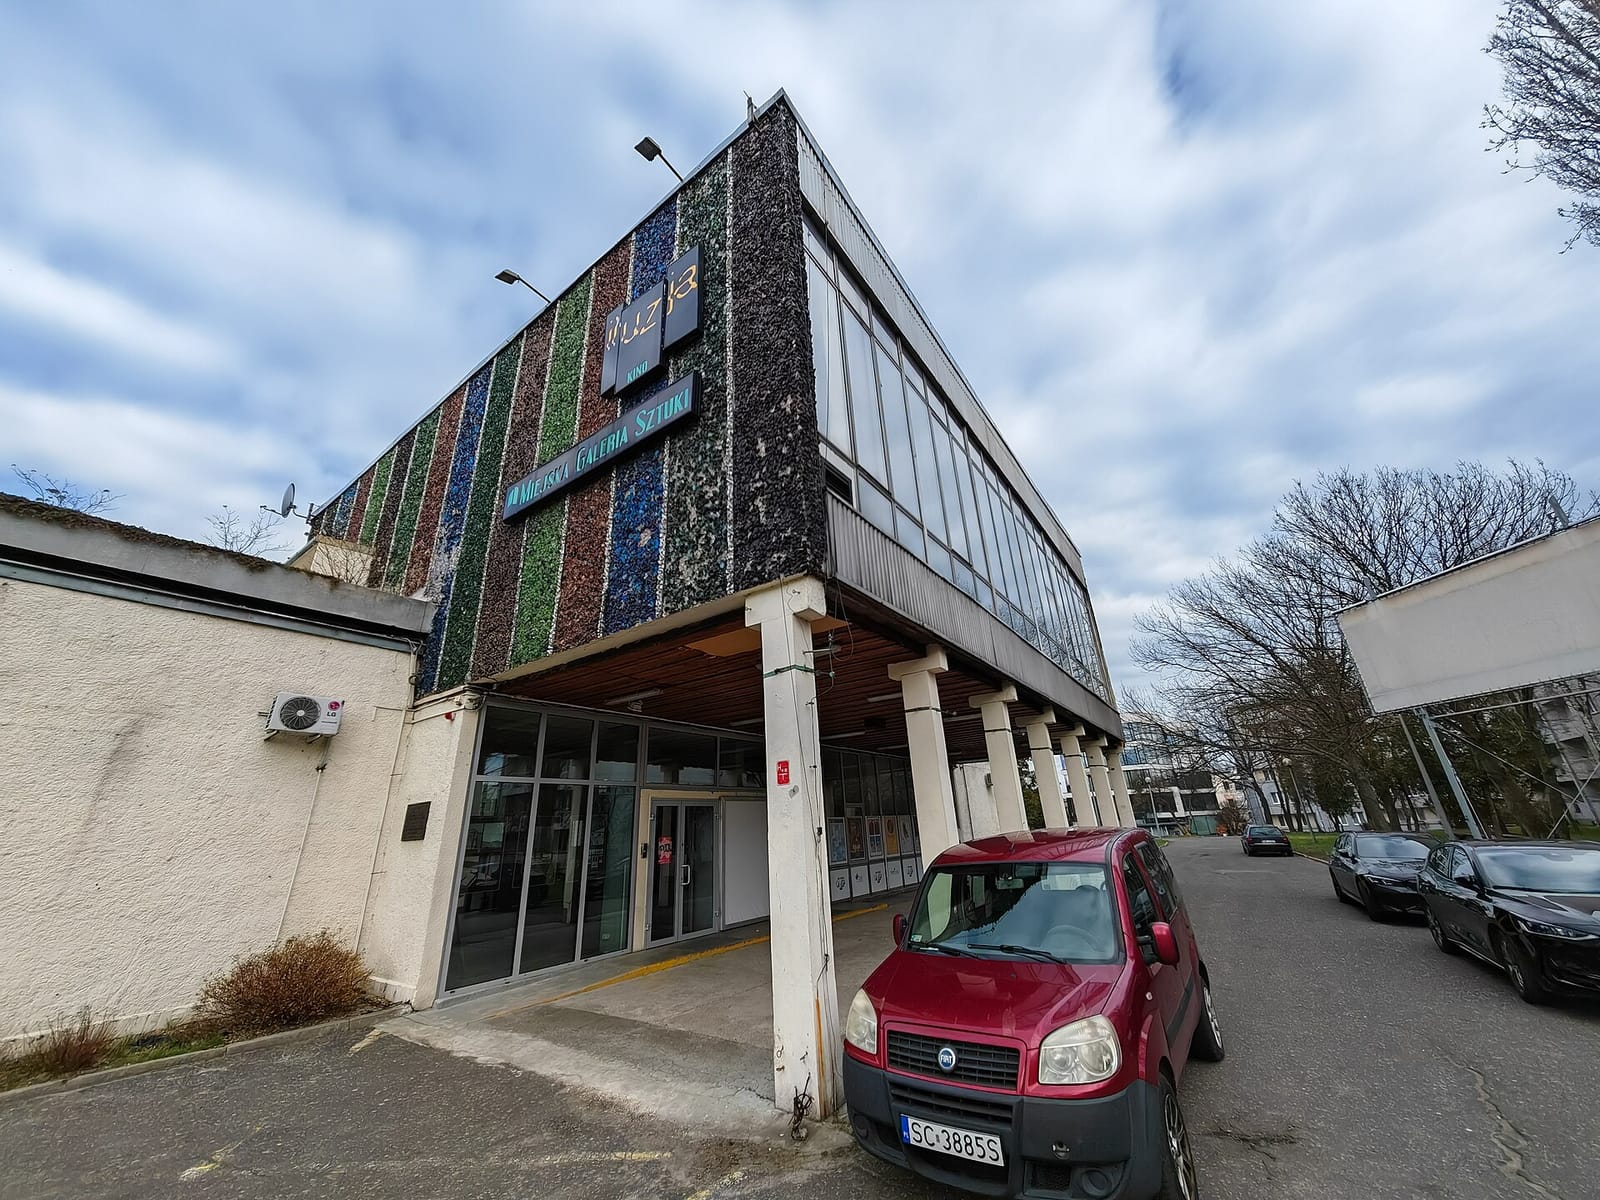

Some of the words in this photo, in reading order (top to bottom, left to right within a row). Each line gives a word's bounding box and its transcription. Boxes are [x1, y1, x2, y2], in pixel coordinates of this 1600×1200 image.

[627, 360, 648, 384] KINO
[576, 427, 628, 473] GALERIA
[634, 388, 690, 437] SZTUKI
[941, 1055, 952, 1064] FIAT
[911, 1122, 935, 1147] SC
[941, 1129, 1000, 1162] 3885S
